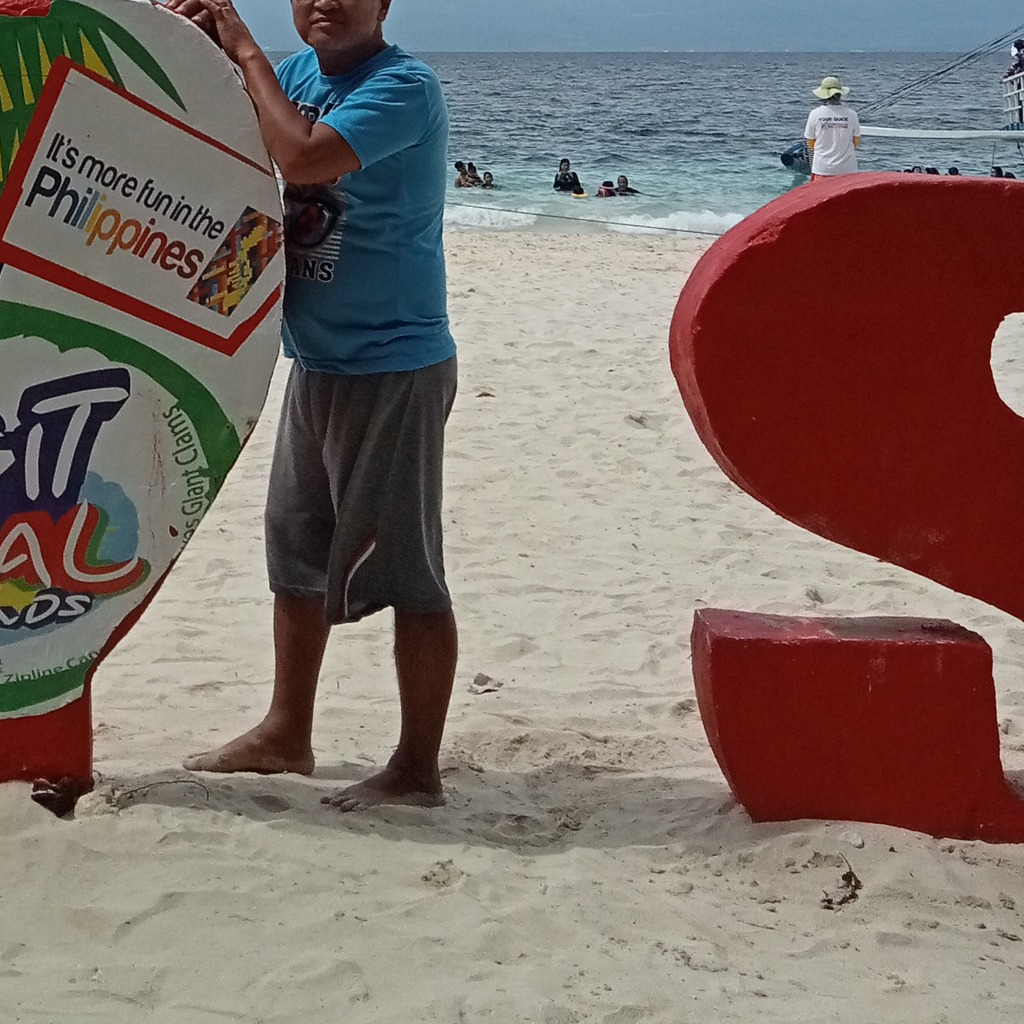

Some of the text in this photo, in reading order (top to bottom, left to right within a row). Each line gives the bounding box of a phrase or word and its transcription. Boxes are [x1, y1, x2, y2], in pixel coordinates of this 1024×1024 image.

[46, 132, 226, 240] It's more fun in the
[24, 165, 205, 280] Philippines
[287, 259, 334, 283] ANS
[162, 403, 199, 466] Clams
[181, 466, 204, 516] Giant
